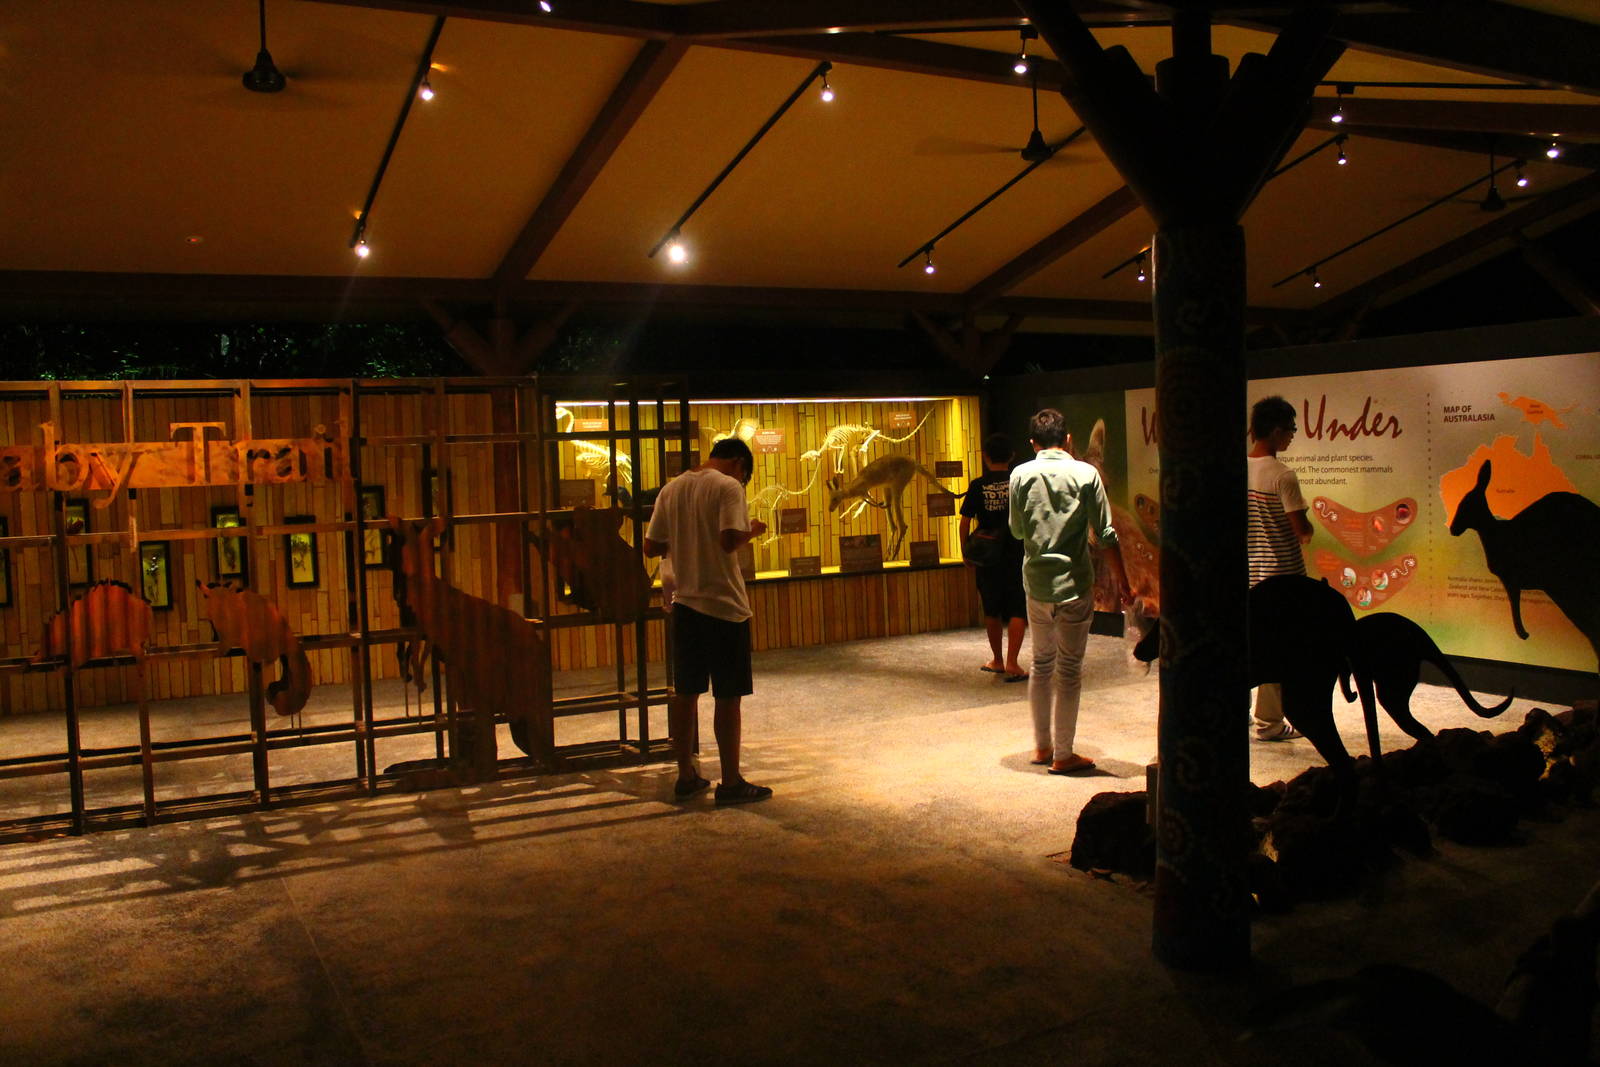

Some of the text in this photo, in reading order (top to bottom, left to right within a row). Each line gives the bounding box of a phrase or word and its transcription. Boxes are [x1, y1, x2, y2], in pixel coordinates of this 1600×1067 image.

[1443, 405, 1472, 414] MAP OF
[1303, 394, 1403, 441] Under
[1443, 413, 1496, 423] AUSTRALASIA
[1295, 454, 1317, 462] animal
[1317, 454, 1330, 462] and
[1330, 453, 1348, 463] plant
[1359, 465, 1393, 473] mammals
[1314, 477, 1348, 485] abundant.
